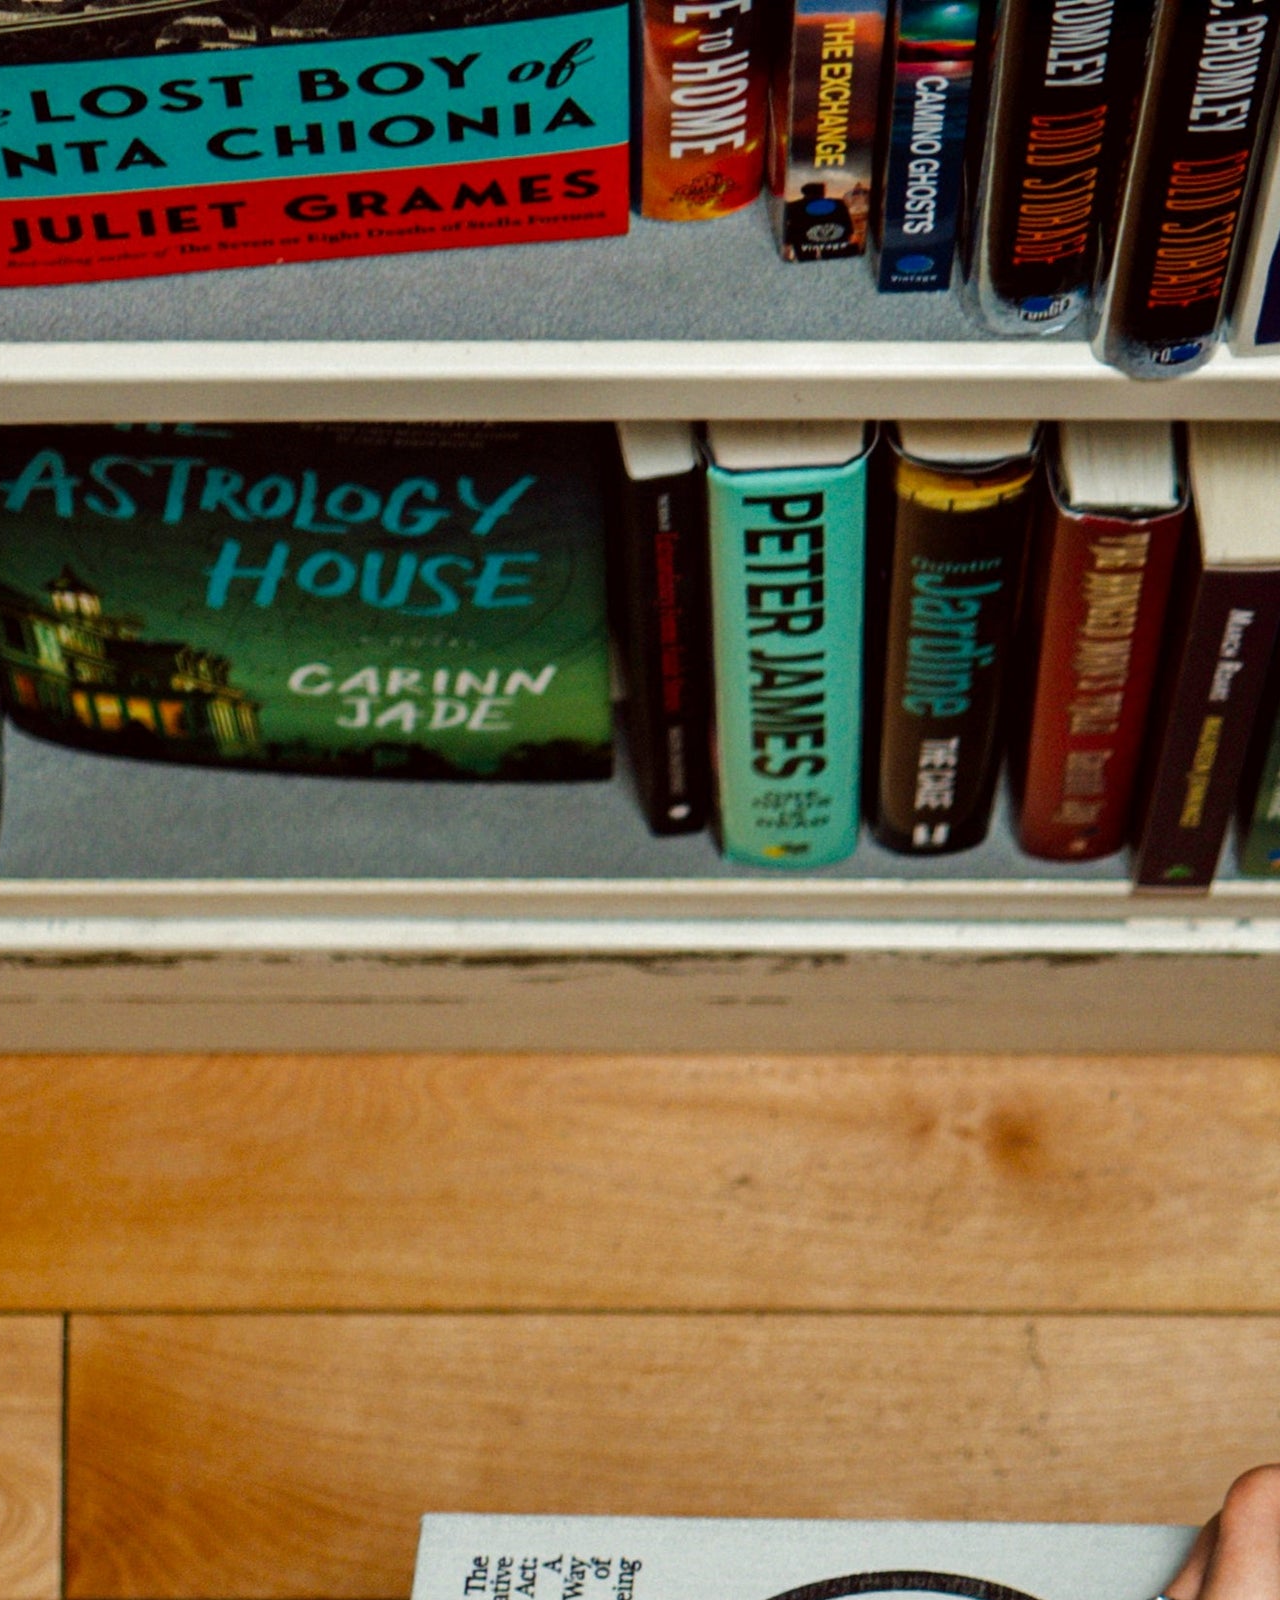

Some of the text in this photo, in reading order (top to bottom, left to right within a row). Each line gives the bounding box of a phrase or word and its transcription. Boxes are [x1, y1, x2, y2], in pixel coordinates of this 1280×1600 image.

[698, 27, 735, 52] TO
[1187, 14, 1269, 134] GRUMLEY
[31, 74, 256, 125] LOST
[298, 51, 486, 104] BOY
[508, 39, 596, 93] of
[670, 50, 750, 160] HOME
[814, 18, 856, 168] THE EXCHANGE
[206, 95, 596, 162] CHIONIA
[902, 75, 950, 237] CAMINO GHOSTS
[1026, 104, 1108, 166] COLD
[9, 167, 602, 255] JULIET GRAMES
[1013, 166, 1097, 265] STORAGE
[1165, 149, 1250, 211] COLD
[1148, 211, 1237, 310] STORAGE
[205, 537, 541, 617] HOUSE
[741, 492, 825, 639] PETER
[287, 662, 559, 697] CARINN
[902, 573, 1002, 717] Jardine
[335, 696, 514, 734] JADE
[747, 651, 827, 780] JAMES
[918, 737, 961, 768] THE
[464, 1555, 489, 1597] The
[514, 1556, 539, 1600] Act:
[542, 1554, 564, 1574] A
[593, 1556, 611, 1580] of
